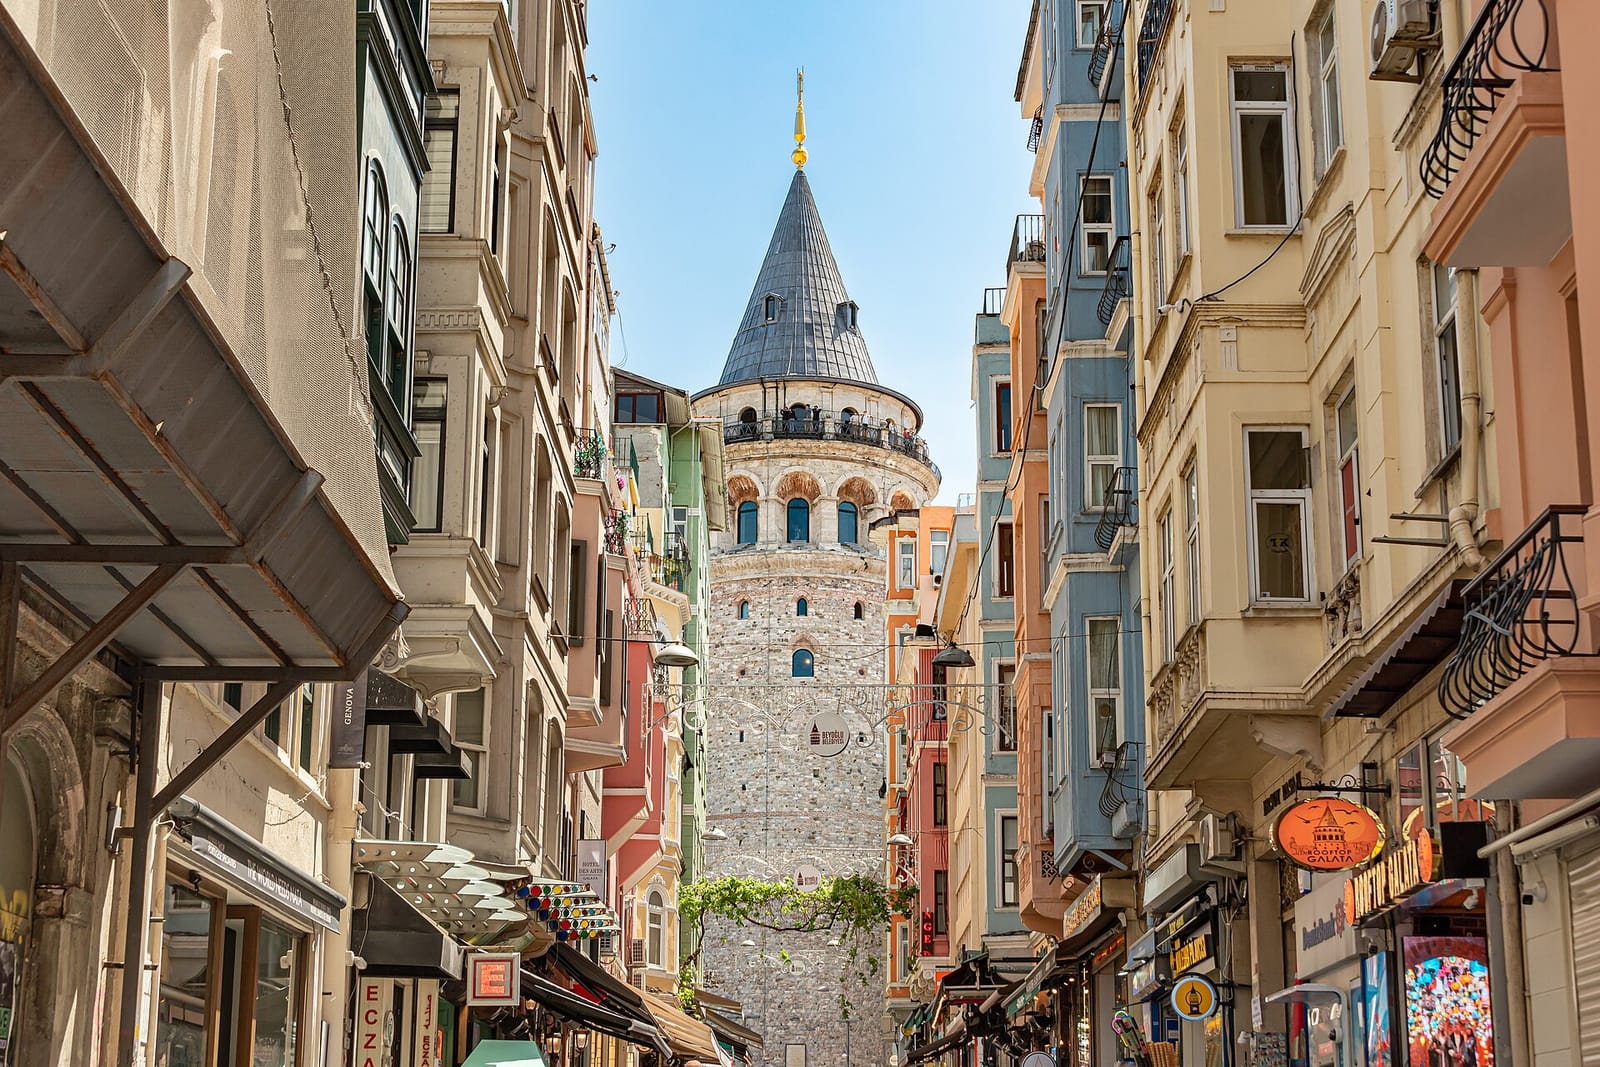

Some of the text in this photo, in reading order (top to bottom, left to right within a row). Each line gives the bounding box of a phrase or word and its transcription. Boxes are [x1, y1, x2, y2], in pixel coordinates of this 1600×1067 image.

[344, 687, 354, 725] GENOVA
[1307, 855, 1354, 863] GALATA
[1387, 840, 1420, 900] GALATA
[480, 964, 506, 994] E
